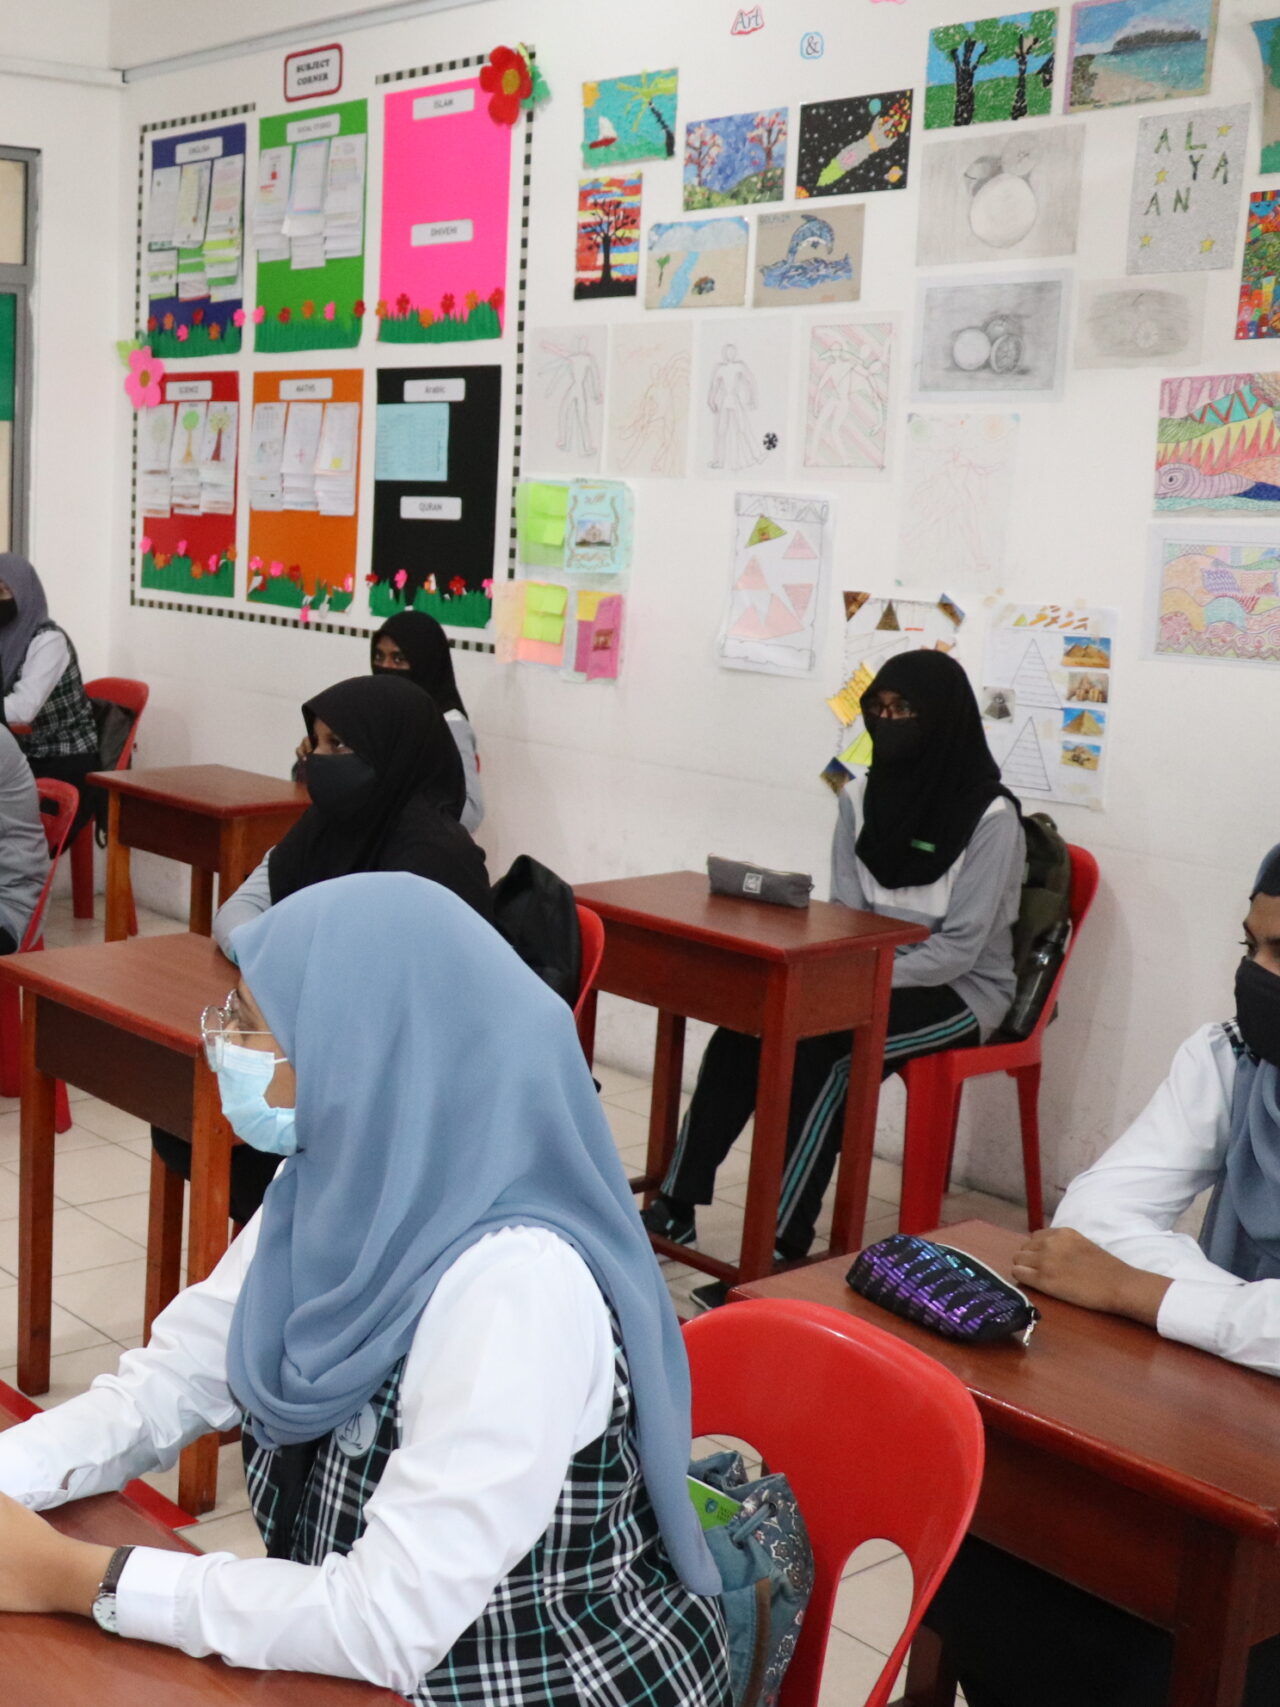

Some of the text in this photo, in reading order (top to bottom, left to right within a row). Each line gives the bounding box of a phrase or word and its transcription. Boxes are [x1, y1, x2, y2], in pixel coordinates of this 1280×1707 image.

[734, 8, 761, 31] Art
[805, 36, 820, 56] &
[295, 58, 331, 73] SUBJECT
[296, 72, 329, 87] CORNER
[433, 98, 454, 109] ISLAM
[430, 226, 458, 237] DHIVEHI
[418, 502, 443, 512] QURAN
